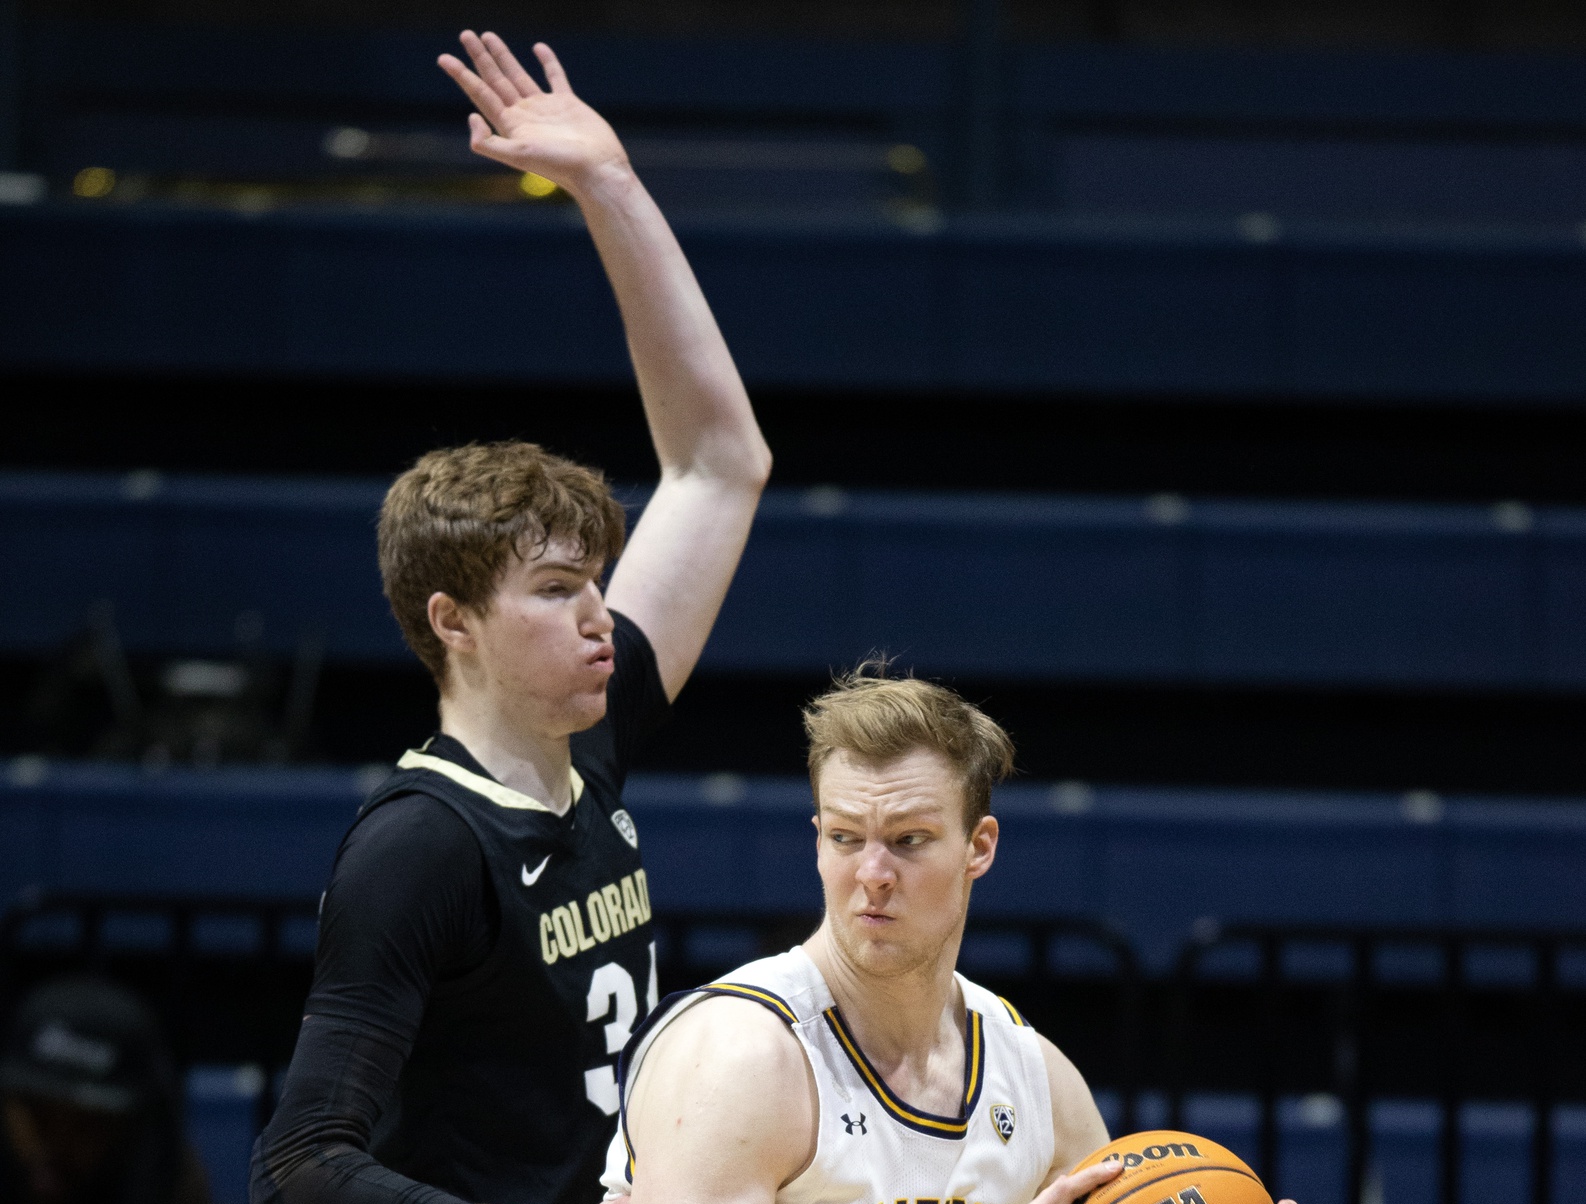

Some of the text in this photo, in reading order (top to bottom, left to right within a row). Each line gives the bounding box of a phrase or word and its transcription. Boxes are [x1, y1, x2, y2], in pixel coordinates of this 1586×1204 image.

[539, 868, 652, 966] COLORAD
[584, 940, 659, 1117] 3
[1100, 1142, 1204, 1171] son
